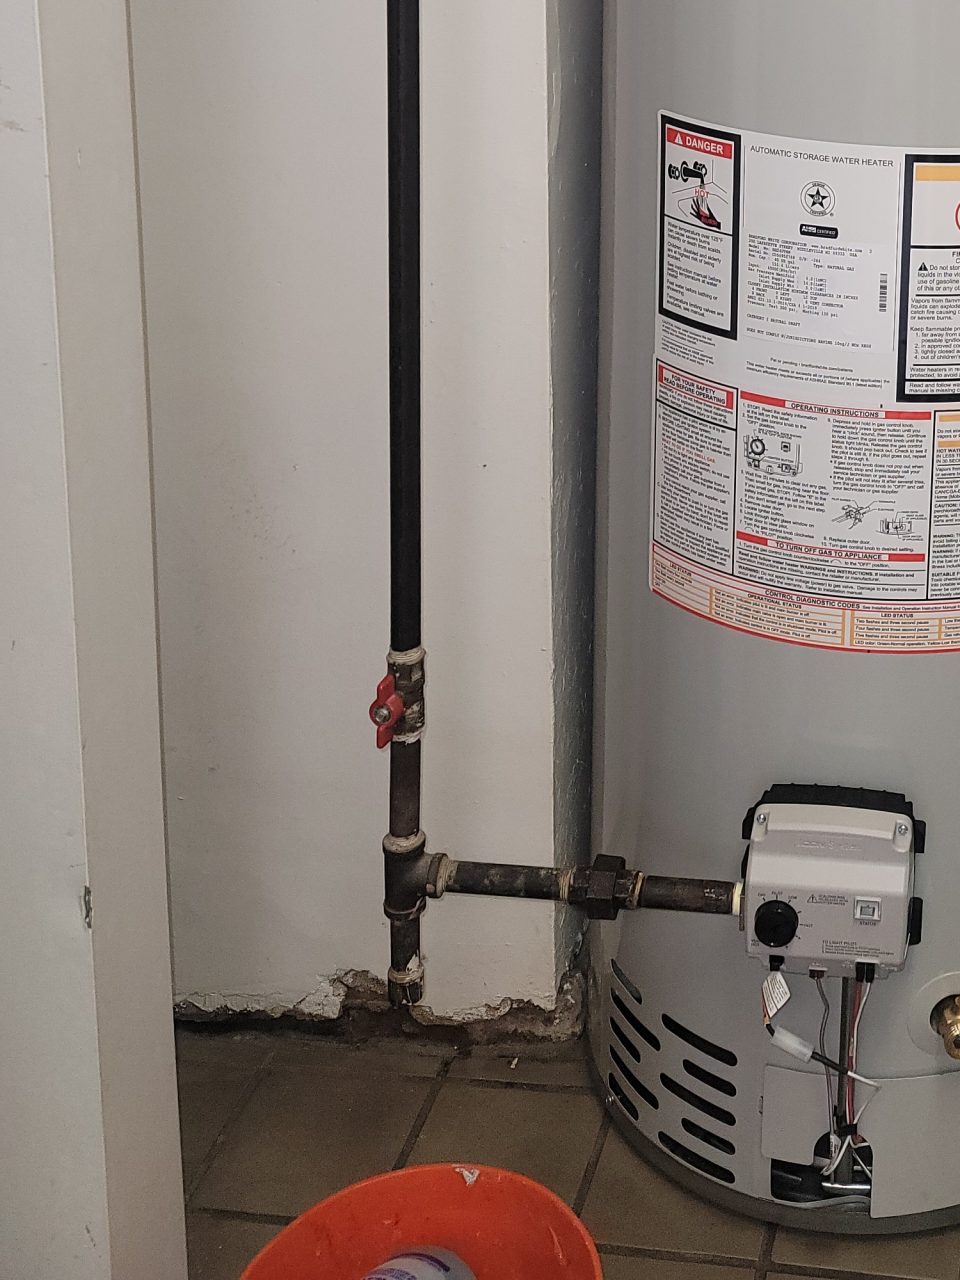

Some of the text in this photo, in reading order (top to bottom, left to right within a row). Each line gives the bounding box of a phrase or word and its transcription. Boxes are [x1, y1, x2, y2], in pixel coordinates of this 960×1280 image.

[686, 136, 724, 154] DANGER
[750, 145, 894, 167] AUTOMATIC STORAGE WATER HEATER
[694, 188, 710, 198] HOT
[935, 278, 960, 286] gasoline
[664, 376, 726, 404] READ BEFORE OPERATING
[681, 378, 695, 387] YOUR
[696, 384, 716, 395] SAFETY
[791, 403, 879, 418] OPERATING INSTRUCTIONS
[786, 544, 803, 553] TURN
[844, 551, 882, 560] APPLIANCE
[747, 593, 802, 610] OPERATIONAL STATUS
[765, 590, 860, 609] CONTROL DIAGNOSTIC CODES
